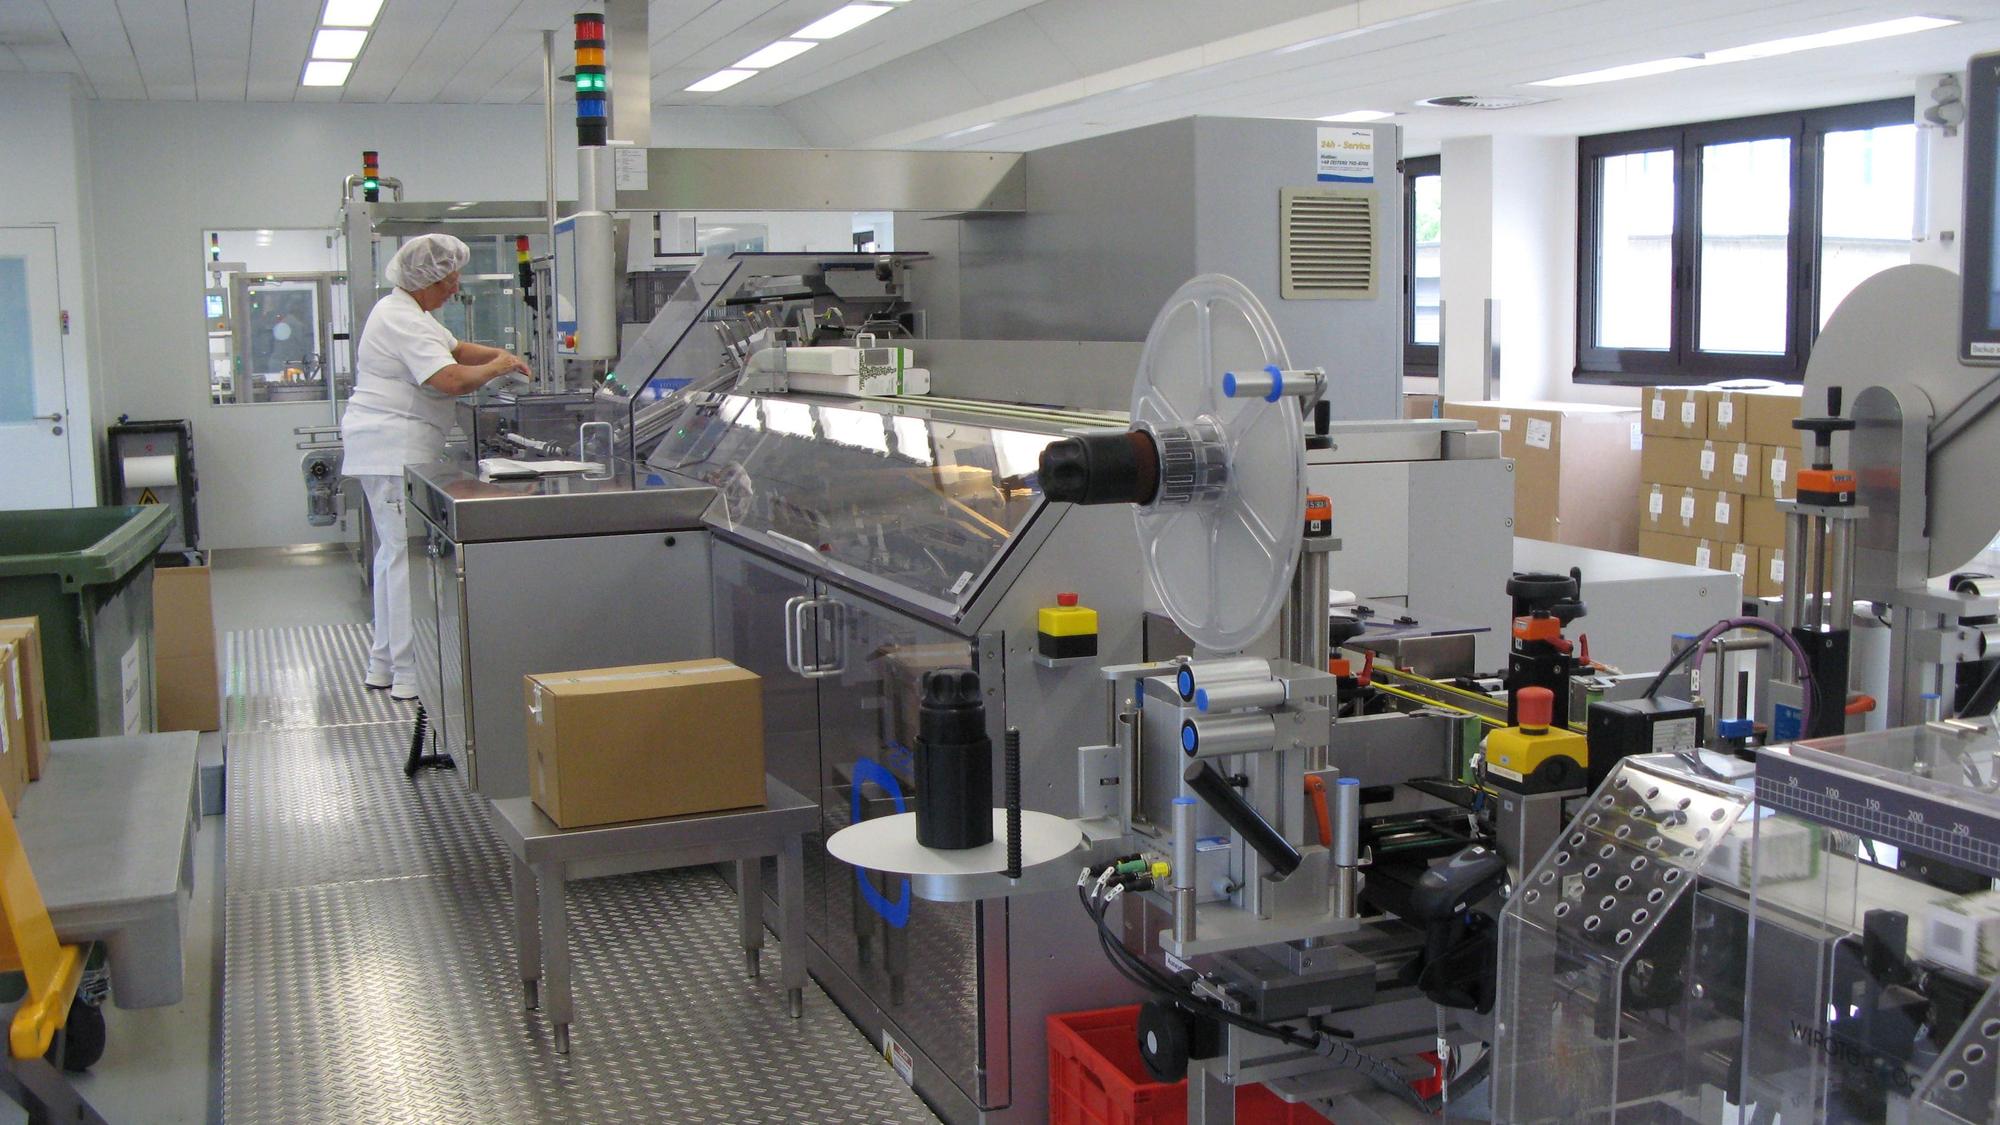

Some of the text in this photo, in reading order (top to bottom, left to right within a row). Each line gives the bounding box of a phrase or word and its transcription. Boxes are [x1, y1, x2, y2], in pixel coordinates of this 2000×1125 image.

[1320, 139, 1336, 149] 24h
[1343, 140, 1371, 150] Service
[1788, 776, 1969, 837] 50 100 150 200 250
